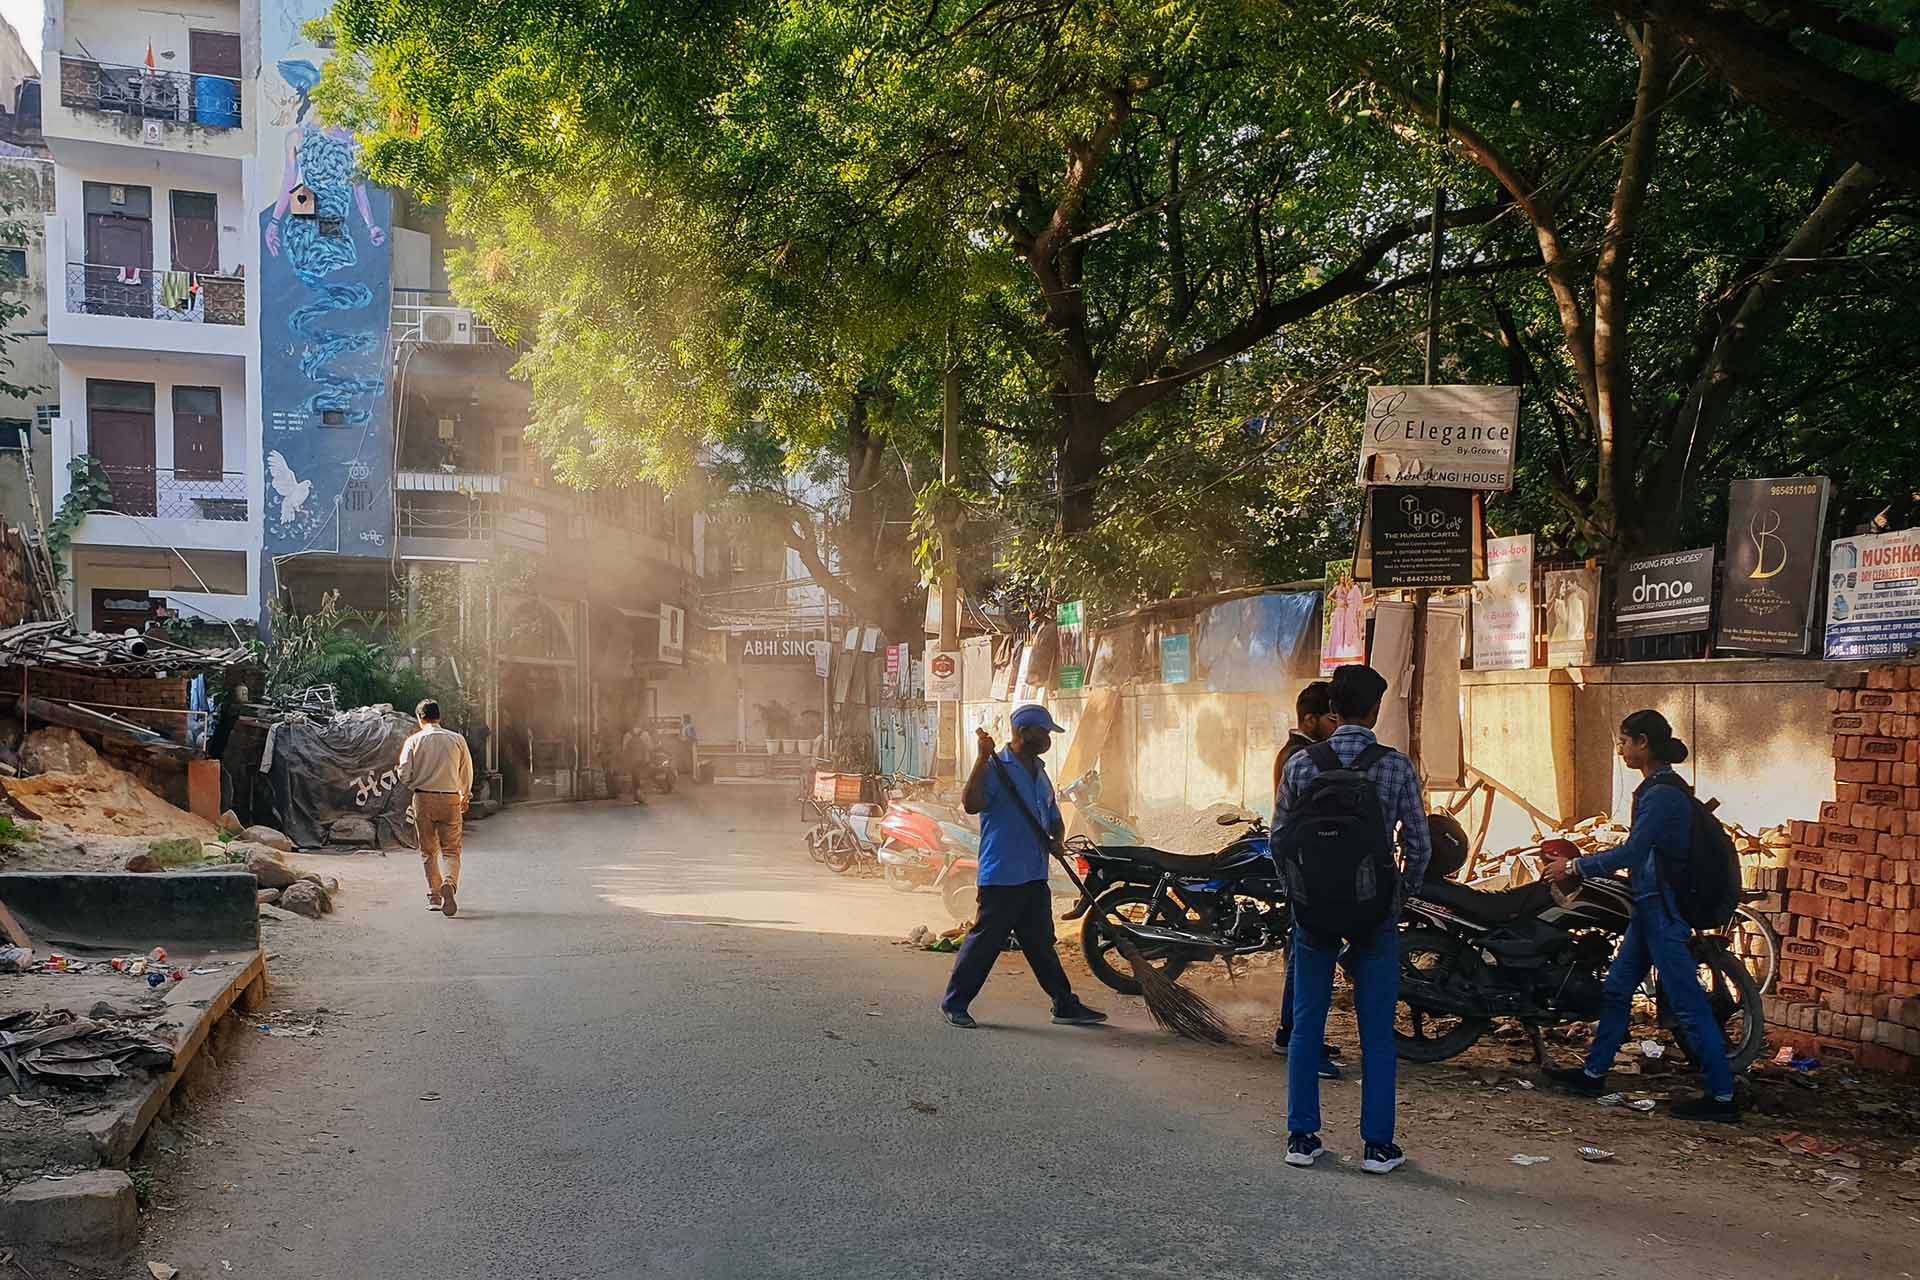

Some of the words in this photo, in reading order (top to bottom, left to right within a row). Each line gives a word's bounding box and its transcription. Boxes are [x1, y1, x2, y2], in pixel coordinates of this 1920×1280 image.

[1405, 420, 1509, 446] Elegance
[1456, 447, 1469, 455] By
[1470, 446, 1509, 456] Grover's
[1462, 472, 1505, 484] HOUSE
[1629, 559, 1659, 571] LOOKING
[1660, 557, 1674, 567] FOR
[1675, 553, 1703, 565] SHOES?
[743, 640, 778, 656] ABHI
[782, 640, 816, 656] SING
